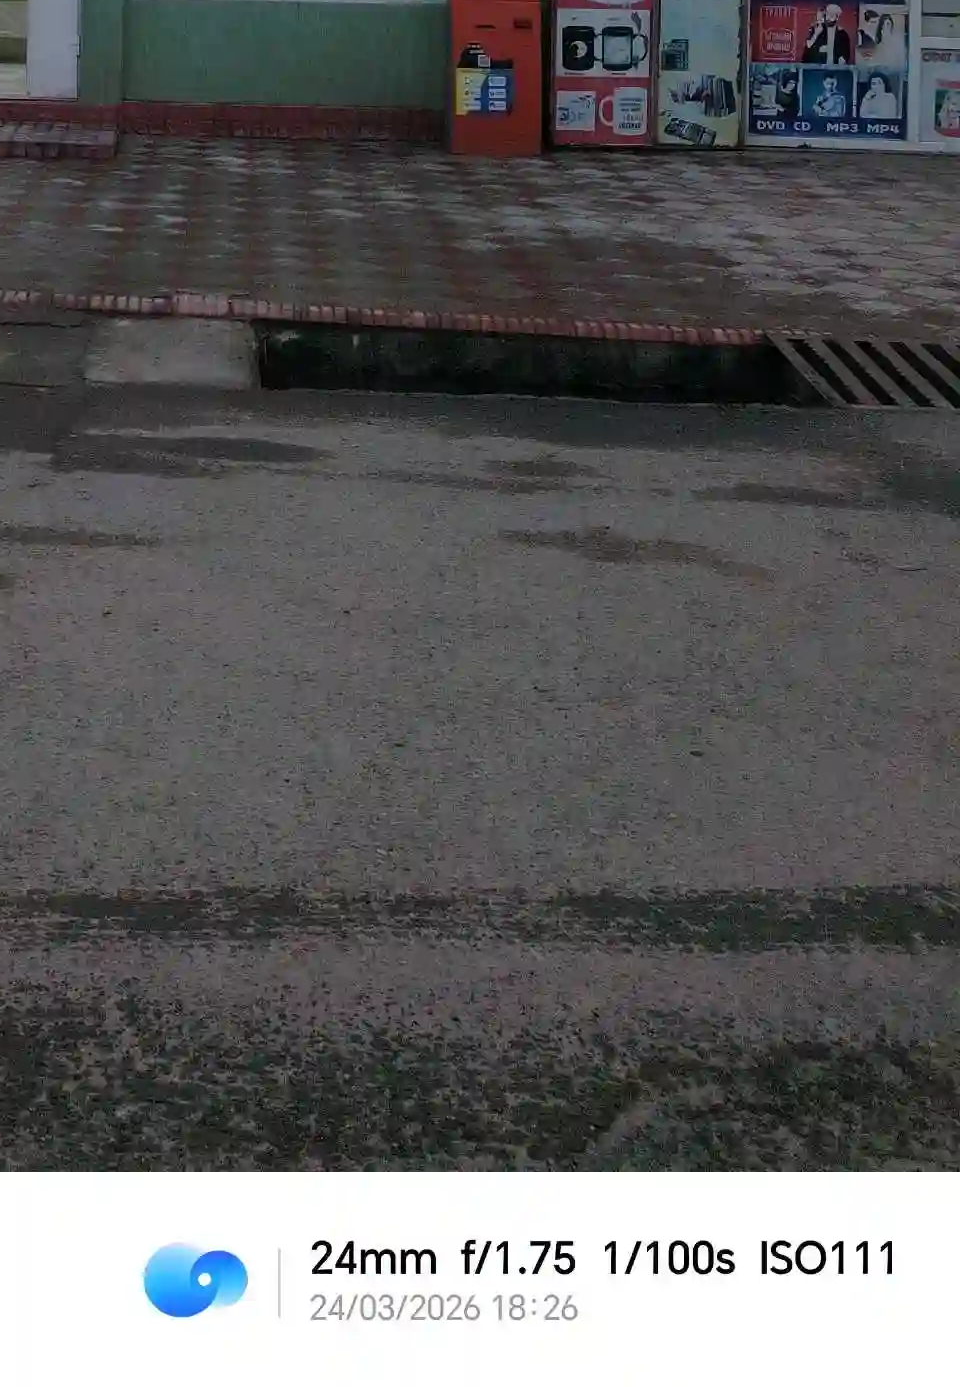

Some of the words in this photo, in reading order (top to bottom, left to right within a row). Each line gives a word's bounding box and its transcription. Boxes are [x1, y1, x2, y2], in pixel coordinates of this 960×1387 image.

[756, 120, 786, 131] DVD
[793, 121, 812, 131] CD
[826, 122, 859, 133] MP3
[866, 123, 900, 134] MP4
